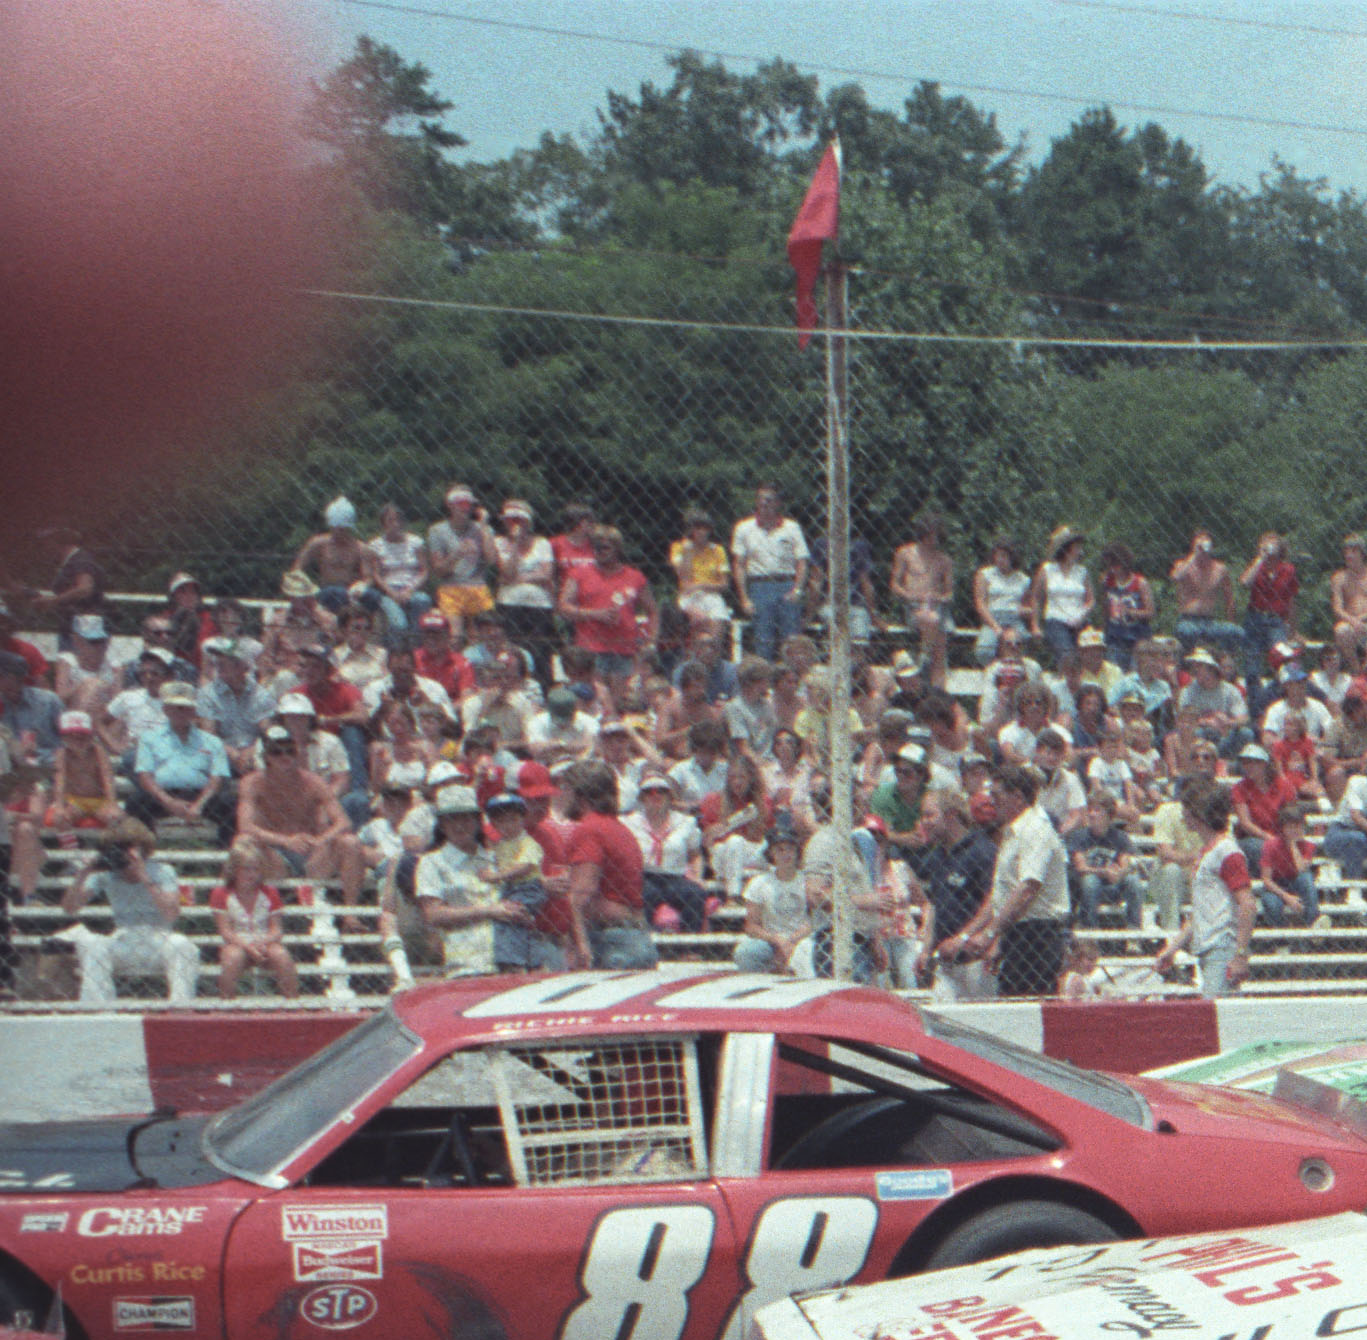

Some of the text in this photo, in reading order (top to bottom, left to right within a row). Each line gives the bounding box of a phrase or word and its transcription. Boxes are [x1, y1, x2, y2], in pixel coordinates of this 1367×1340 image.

[286, 1212, 383, 1233] Winston
[70, 1262, 207, 1284] Curtis Rice
[119, 1305, 190, 1320] CHAMPION
[311, 1289, 367, 1321] STP
